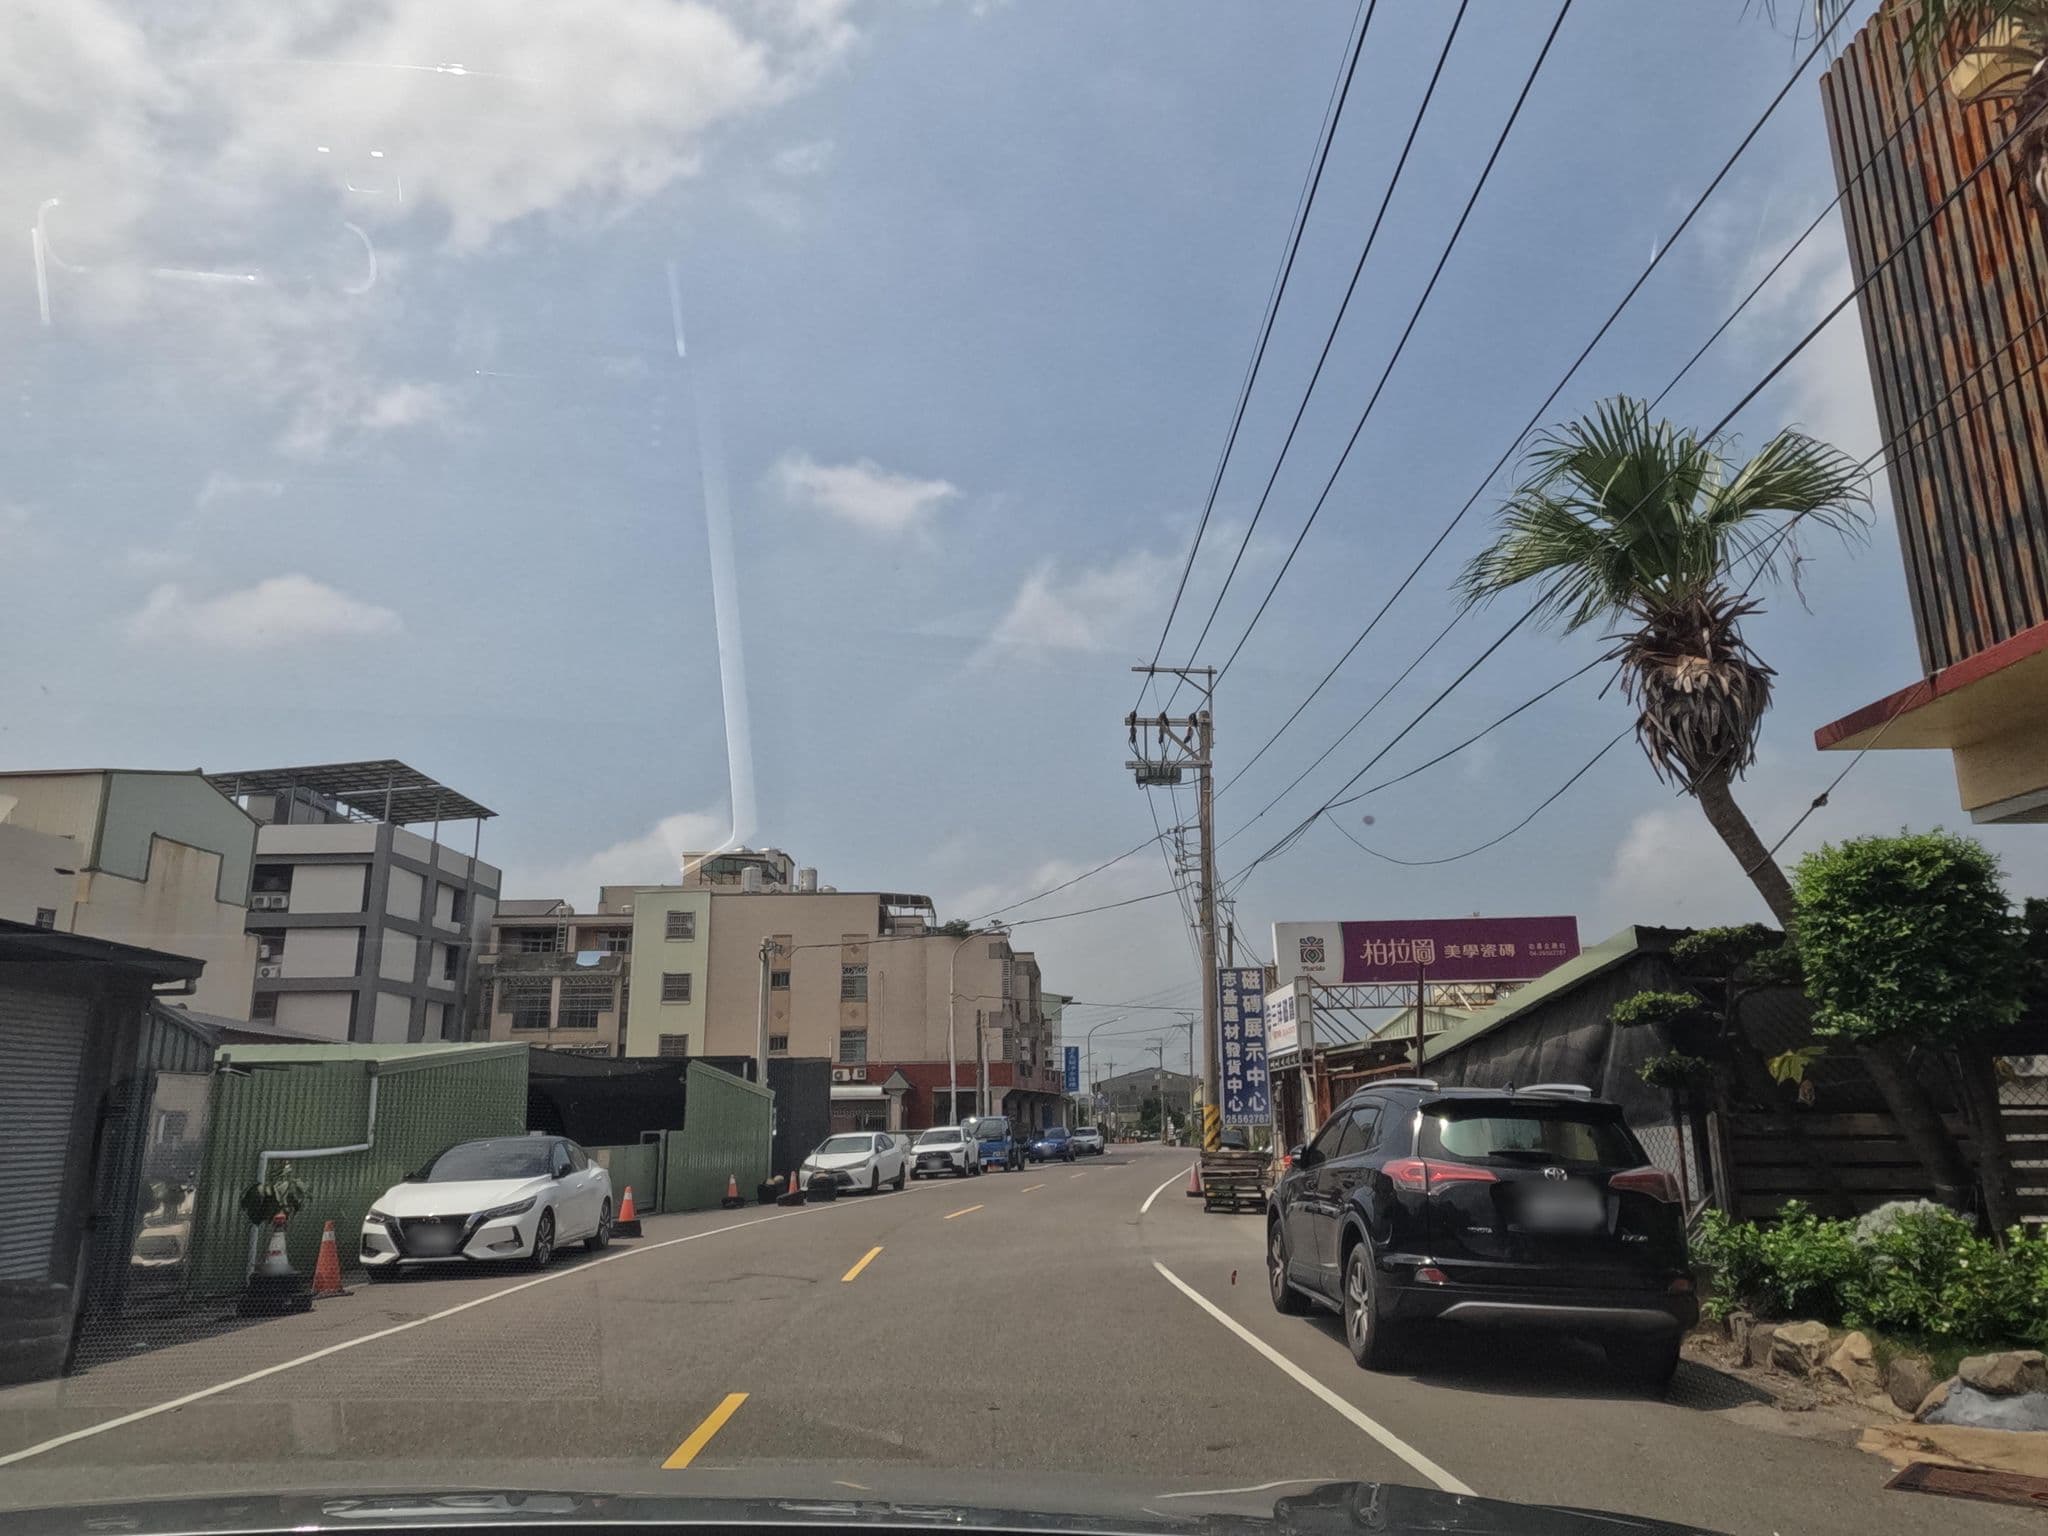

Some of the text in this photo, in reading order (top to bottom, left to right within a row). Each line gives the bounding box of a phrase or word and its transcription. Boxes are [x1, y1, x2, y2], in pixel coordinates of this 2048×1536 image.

[1360, 938, 1436, 967] 柏拉圖
[1444, 943, 1516, 959] 美學瓷磚
[1221, 971, 1244, 1113] 志基建材發貨中心
[1240, 970, 1267, 1112] 磁磚展示中心
[1225, 1113, 1270, 1125] 25562787
